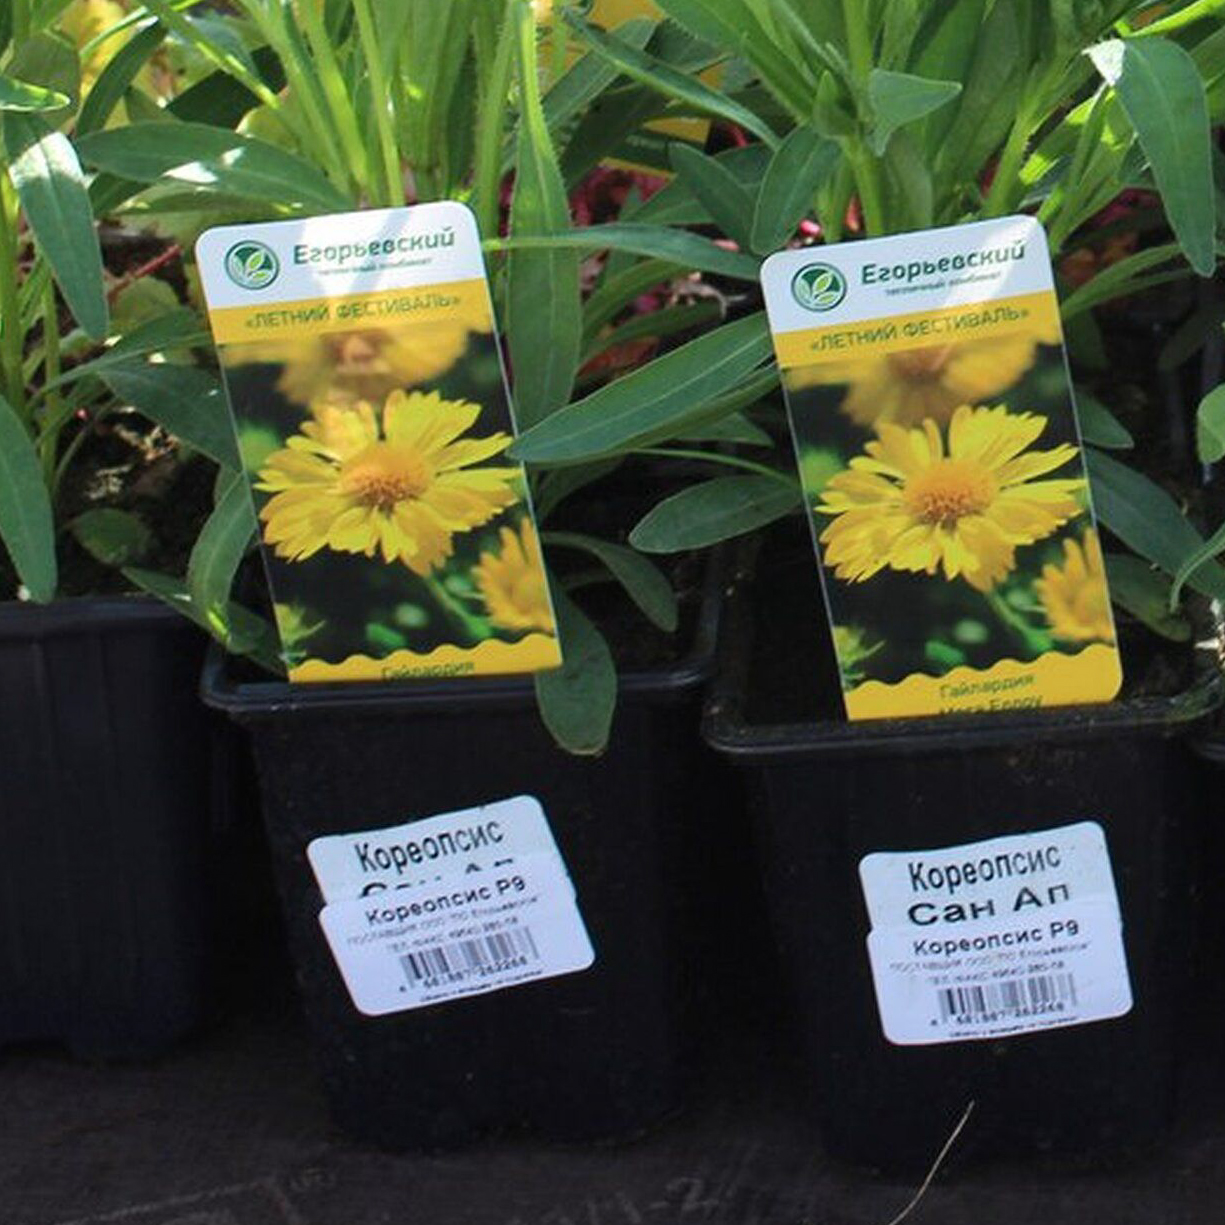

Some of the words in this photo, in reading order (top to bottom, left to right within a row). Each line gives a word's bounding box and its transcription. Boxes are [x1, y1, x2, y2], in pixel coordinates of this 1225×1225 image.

[293, 225, 455, 265] Егорьевский
[860, 239, 1027, 286] Егорьевский
[353, 820, 505, 876] Кореопсис
[907, 845, 1062, 896] Кореопсис
[364, 884, 491, 928] Кореопсис
[907, 898, 996, 927] Сан
[1013, 883, 1070, 913] Ап
[912, 926, 1043, 958] Кореопсис
